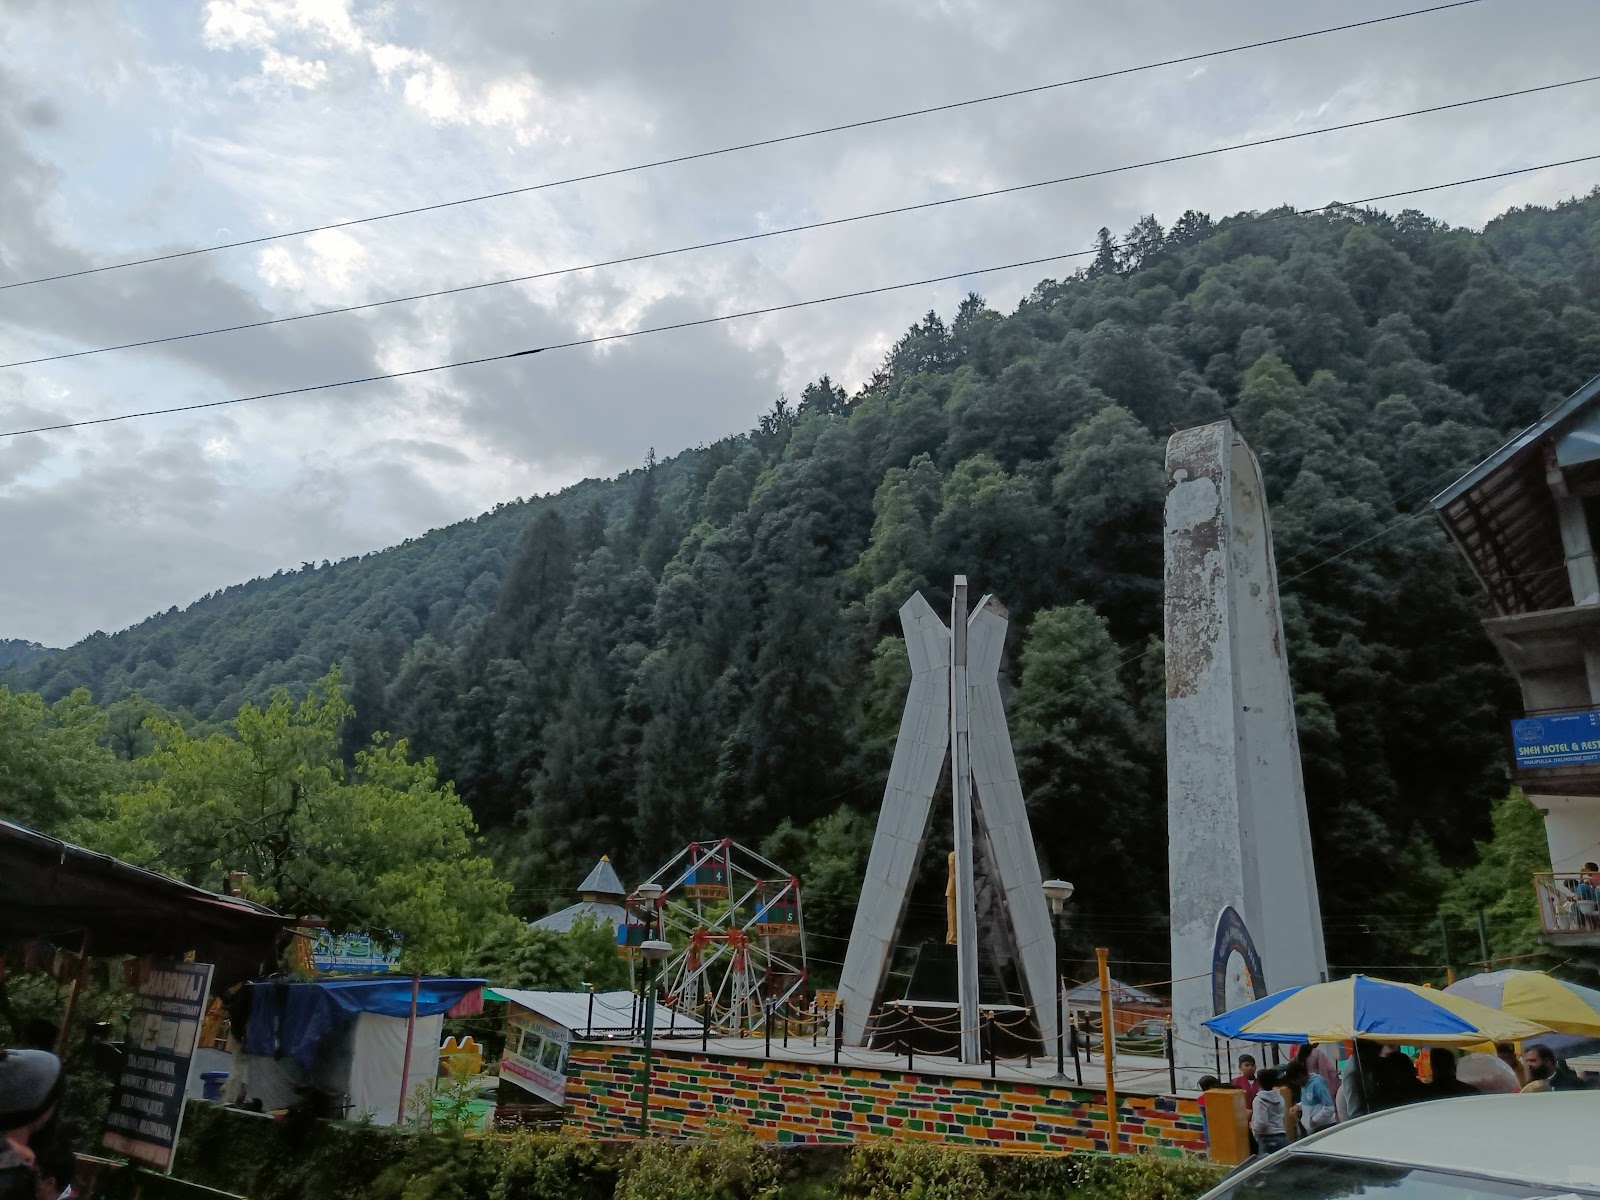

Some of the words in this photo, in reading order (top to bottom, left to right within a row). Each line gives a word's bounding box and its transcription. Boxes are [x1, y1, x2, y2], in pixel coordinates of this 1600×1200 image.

[1519, 746, 1540, 755] SNEH
[1542, 744, 1569, 754] HOTEL
[1571, 742, 1579, 751] &
[716, 871, 722, 882] 4
[787, 911, 793, 921] 5
